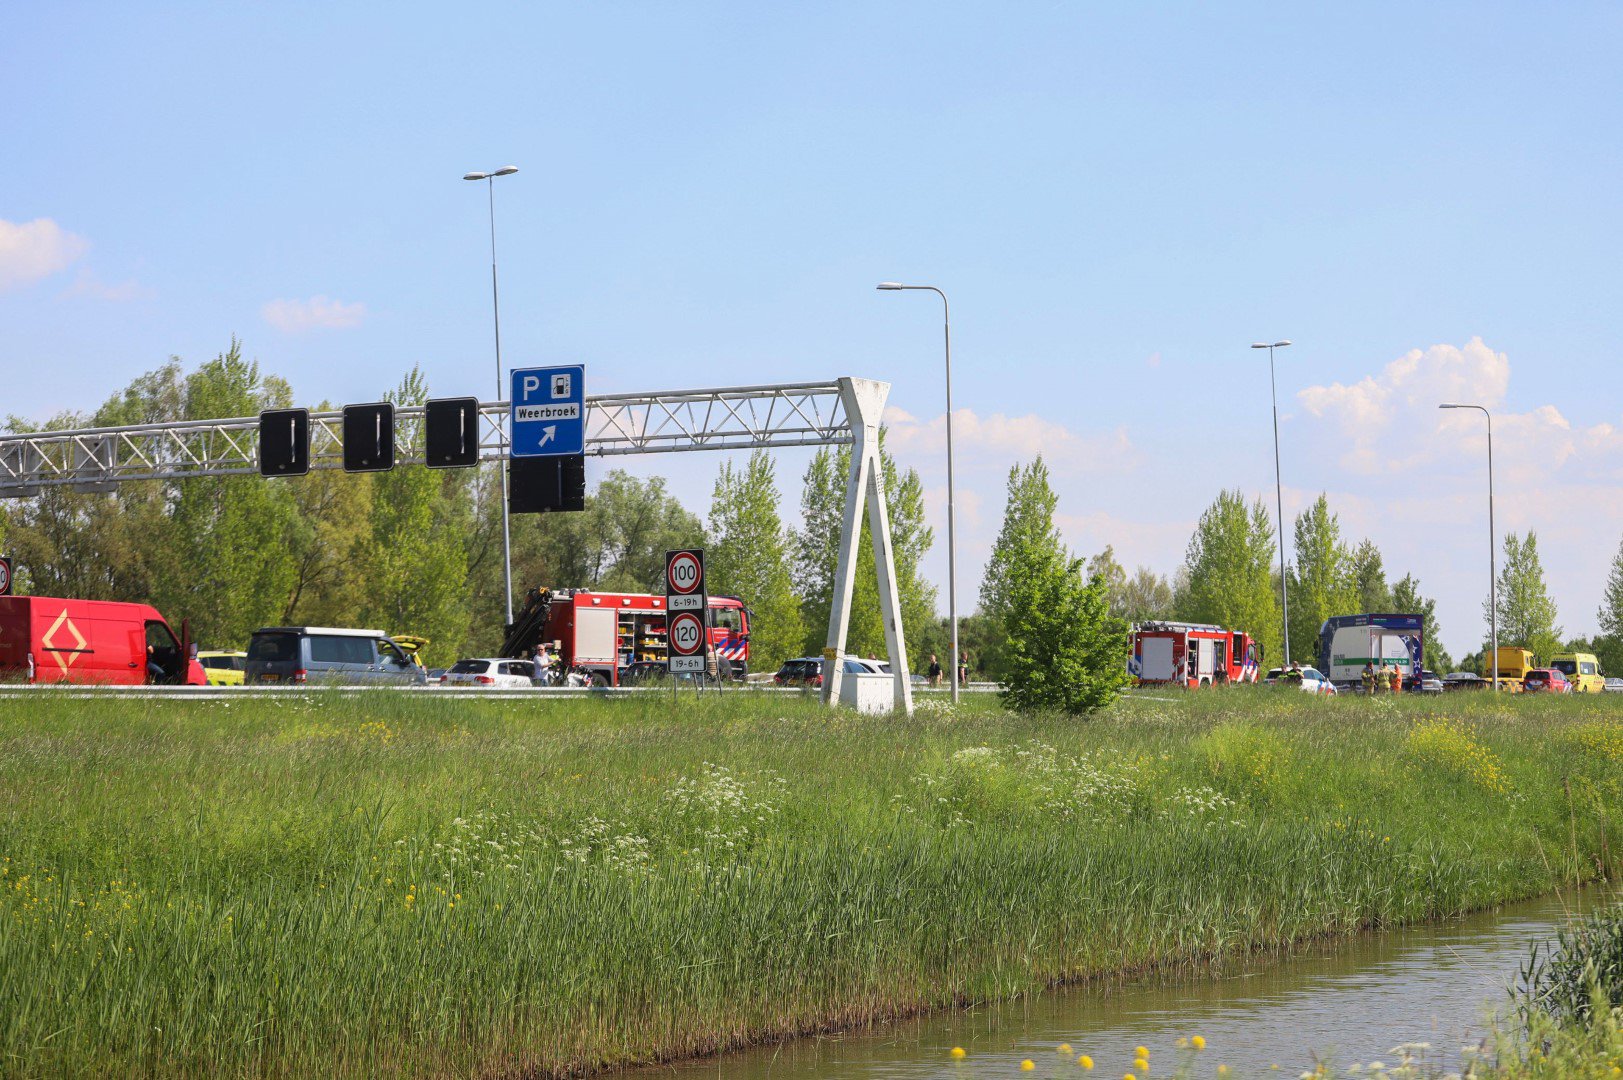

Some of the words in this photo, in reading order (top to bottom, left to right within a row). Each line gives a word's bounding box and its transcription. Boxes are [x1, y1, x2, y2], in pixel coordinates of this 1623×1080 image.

[523, 376, 540, 401] P
[518, 406, 576, 419] Weerbroek
[674, 565, 695, 580] 100
[676, 626, 697, 641] 120
